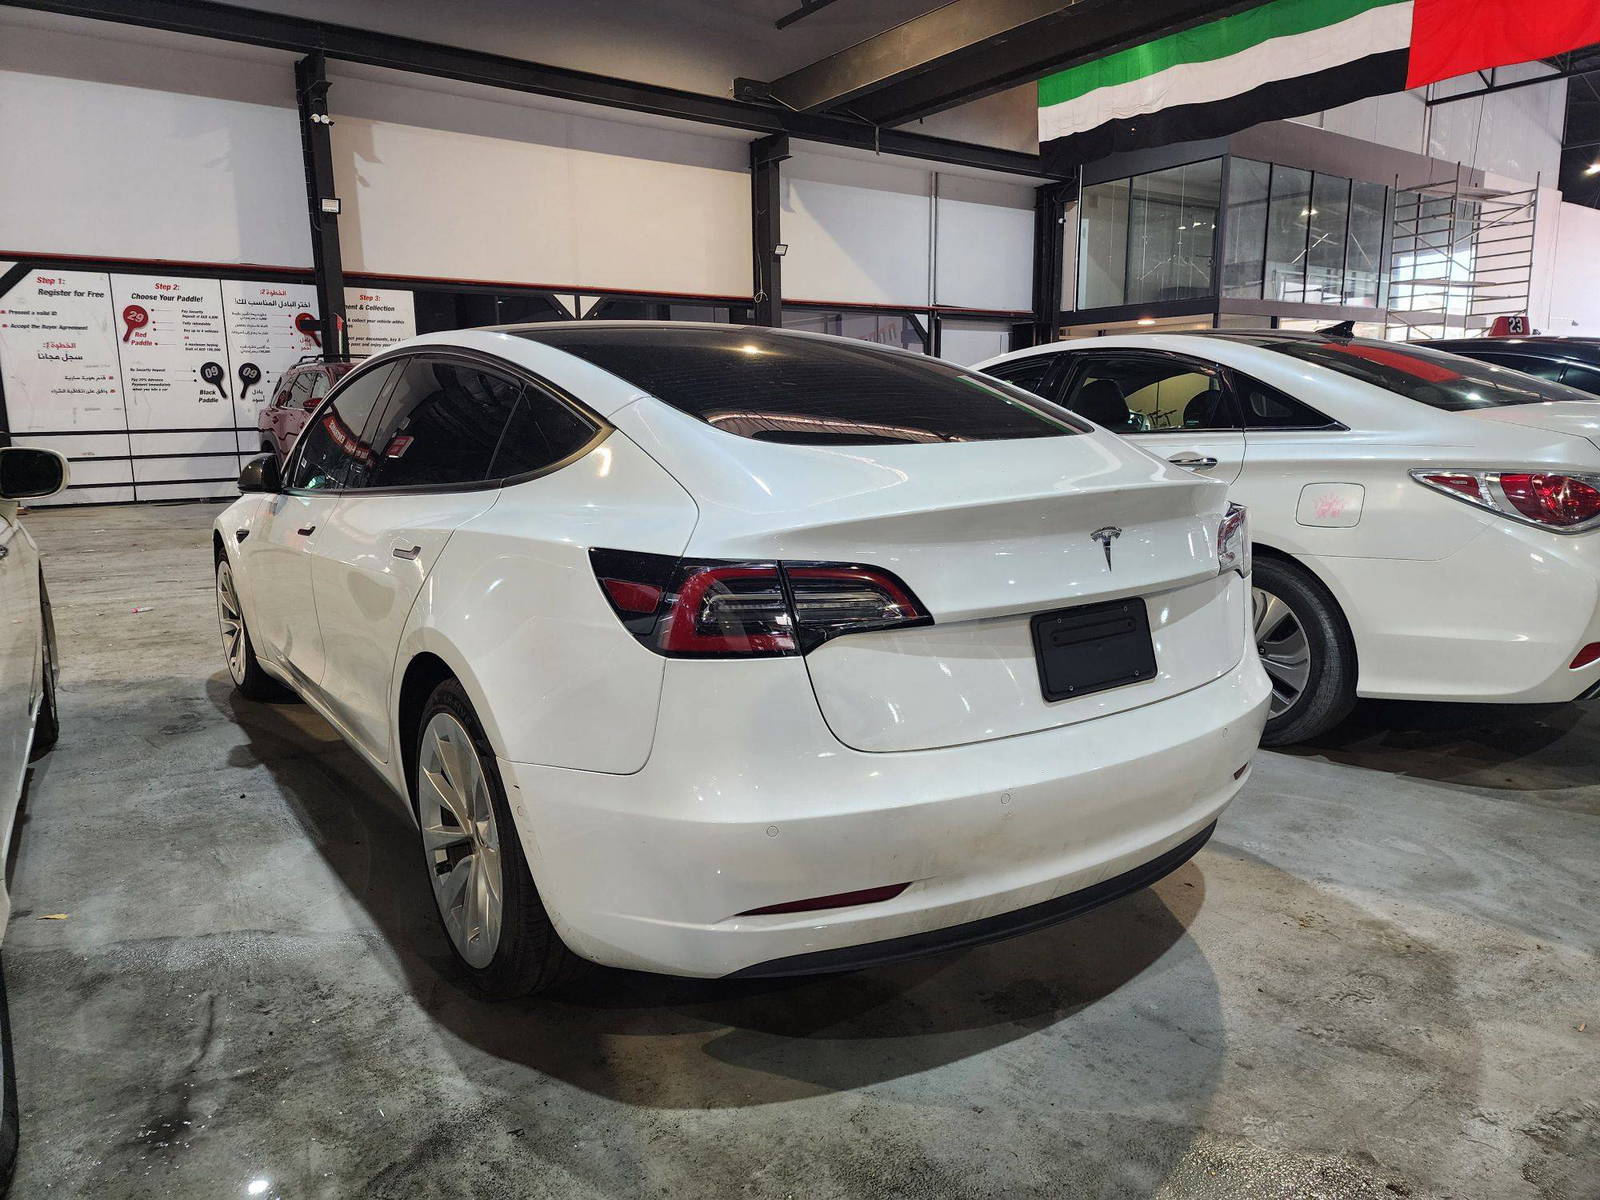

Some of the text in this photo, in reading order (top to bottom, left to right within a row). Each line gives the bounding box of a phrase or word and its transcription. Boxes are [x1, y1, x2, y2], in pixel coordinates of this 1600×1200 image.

[36, 276, 55, 285] Step
[155, 283, 171, 291] Step
[38, 288, 71, 297] Register
[131, 292, 203, 303] Choose Your Paddle!
[360, 294, 373, 302] Step
[248, 299, 277, 307] المناسب
[278, 300, 297, 309] البادل
[298, 301, 311, 309] اختر
[365, 304, 395, 312] Collection
[127, 310, 144, 323] 29
[1508, 317, 1523, 333] 23
[51, 342, 77, 350] الخطوة
[61, 353, 83, 362] سجل
[204, 365, 219, 379] 09
[242, 367, 258, 379] 09
